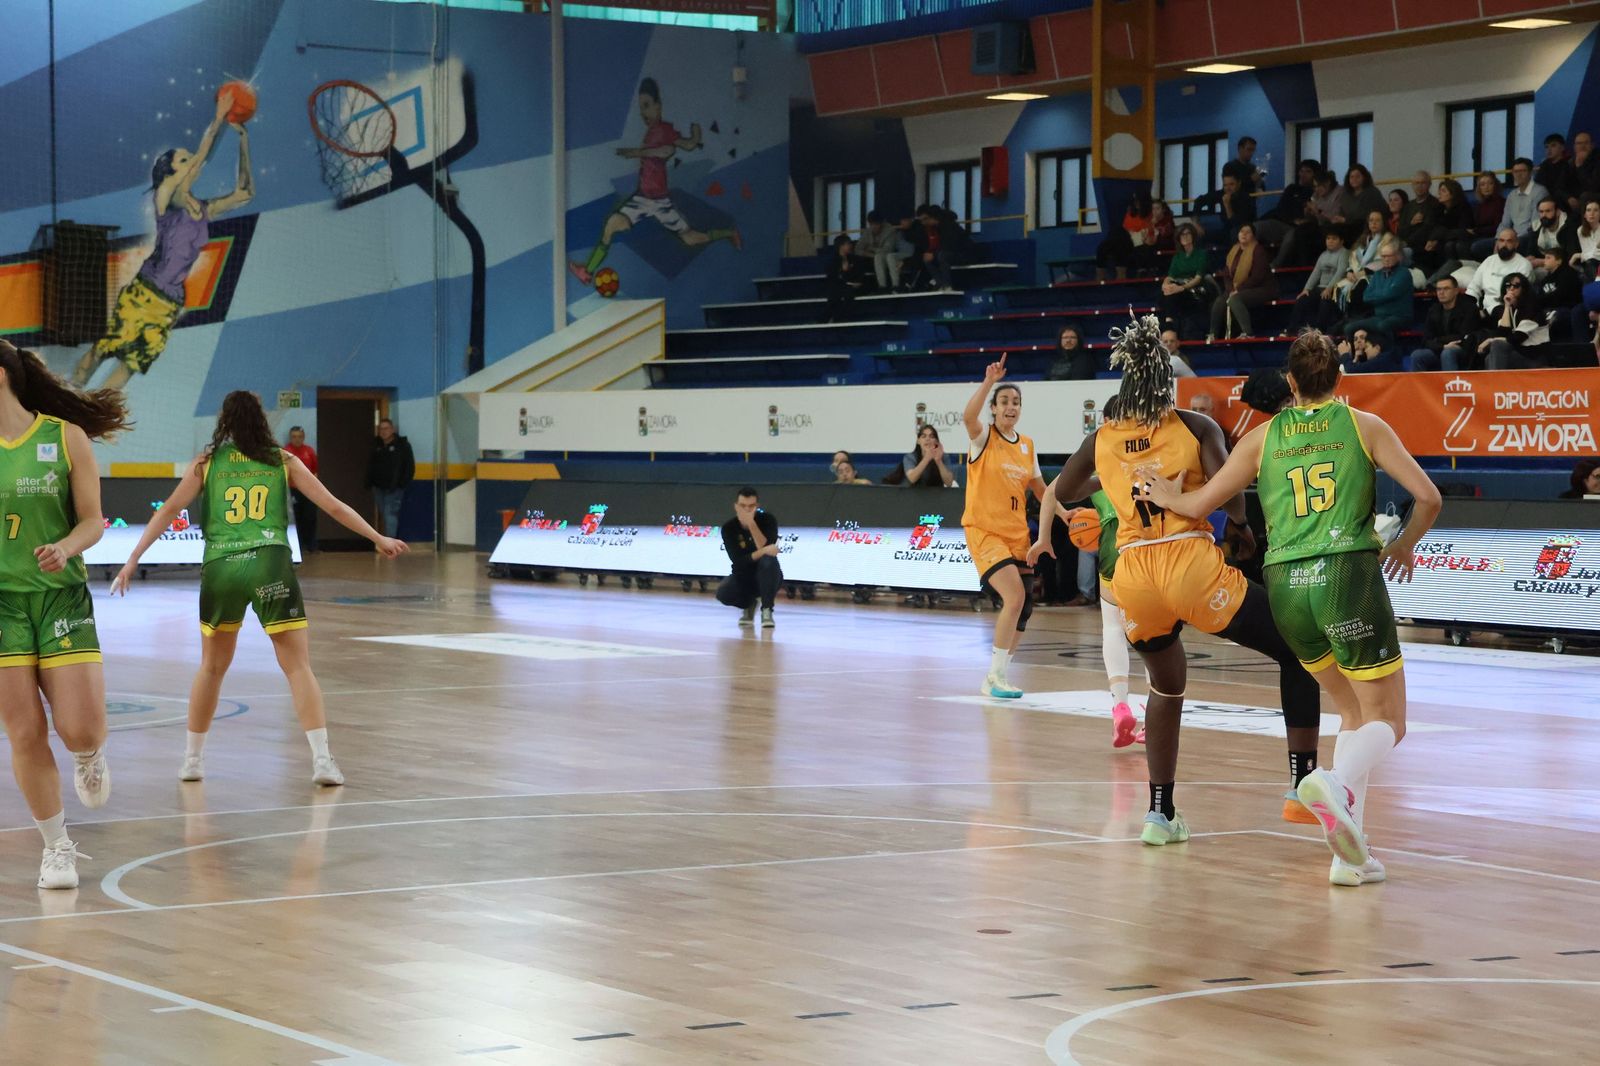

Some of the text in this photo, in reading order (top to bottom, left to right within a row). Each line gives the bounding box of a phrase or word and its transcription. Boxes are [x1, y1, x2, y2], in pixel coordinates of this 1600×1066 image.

[528, 415, 554, 428] ZAMORA
[648, 415, 677, 428] ZAMORA
[779, 414, 812, 428] ZAMORA
[1284, 419, 1329, 437] LUMELA
[1488, 424, 1598, 452] ZAMORA
[16, 476, 41, 486] alter
[16, 485, 59, 494] enersun
[1287, 461, 1337, 518] 15
[224, 484, 269, 525] 30
[1011, 496, 1019, 511] 11
[828, 530, 891, 545] IMPULSA
[894, 550, 937, 562] Castilla
[938, 554, 947, 564] y
[1414, 554, 1505, 572] MPULSA
